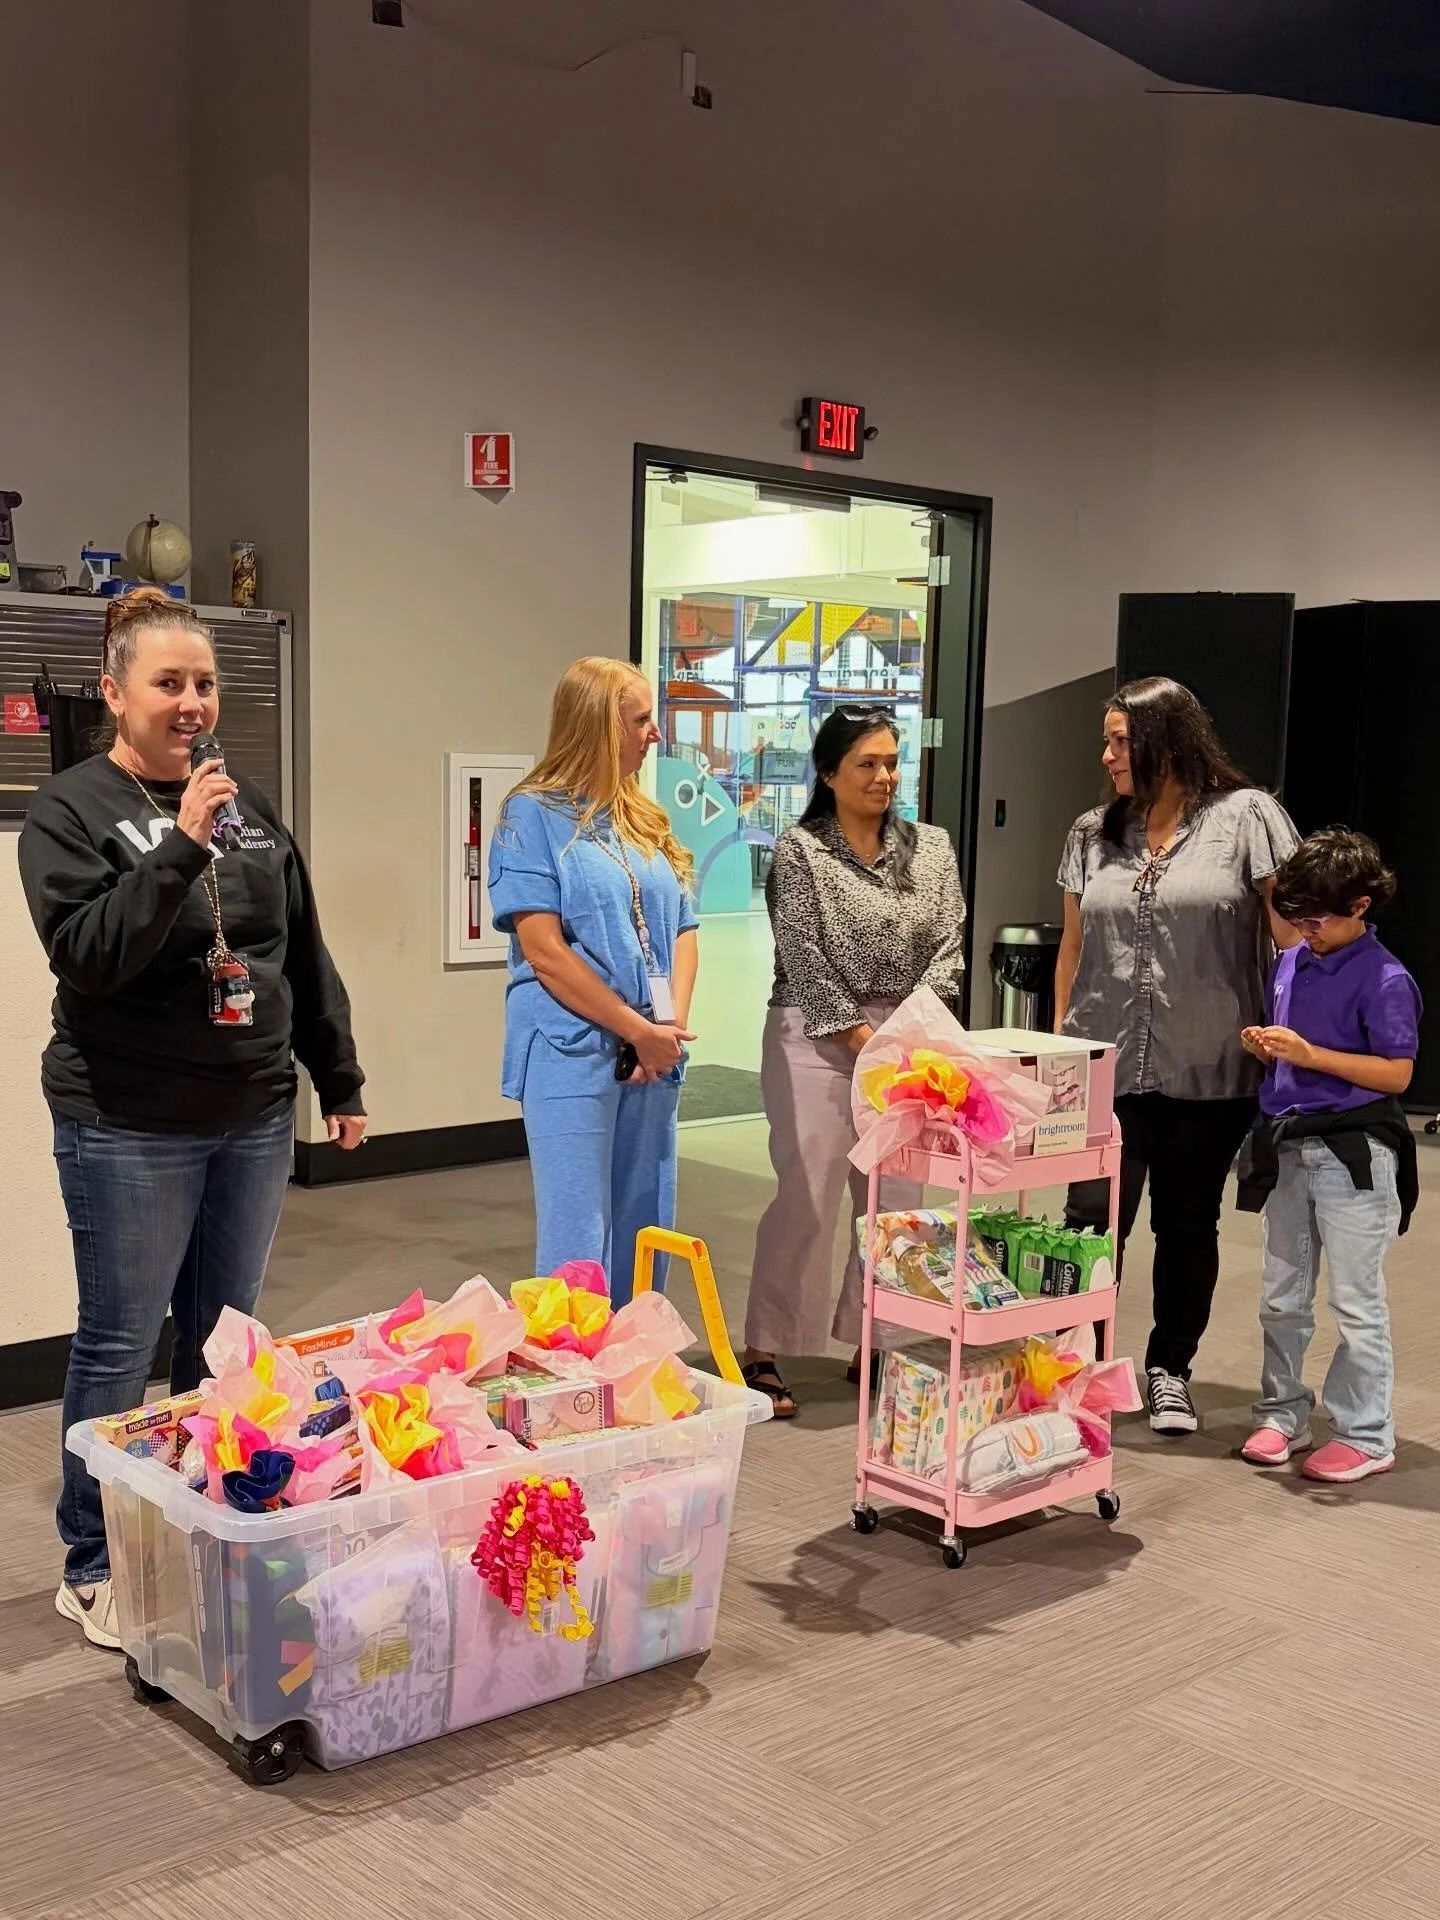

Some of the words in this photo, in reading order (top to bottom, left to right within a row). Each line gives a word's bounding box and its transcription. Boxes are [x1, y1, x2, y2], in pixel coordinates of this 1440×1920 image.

[819, 401, 859, 452] EXIT
[1038, 1122, 1085, 1137] brightroom
[301, 1337, 338, 1354] FoxMind
[128, 1419, 150, 1433] made
